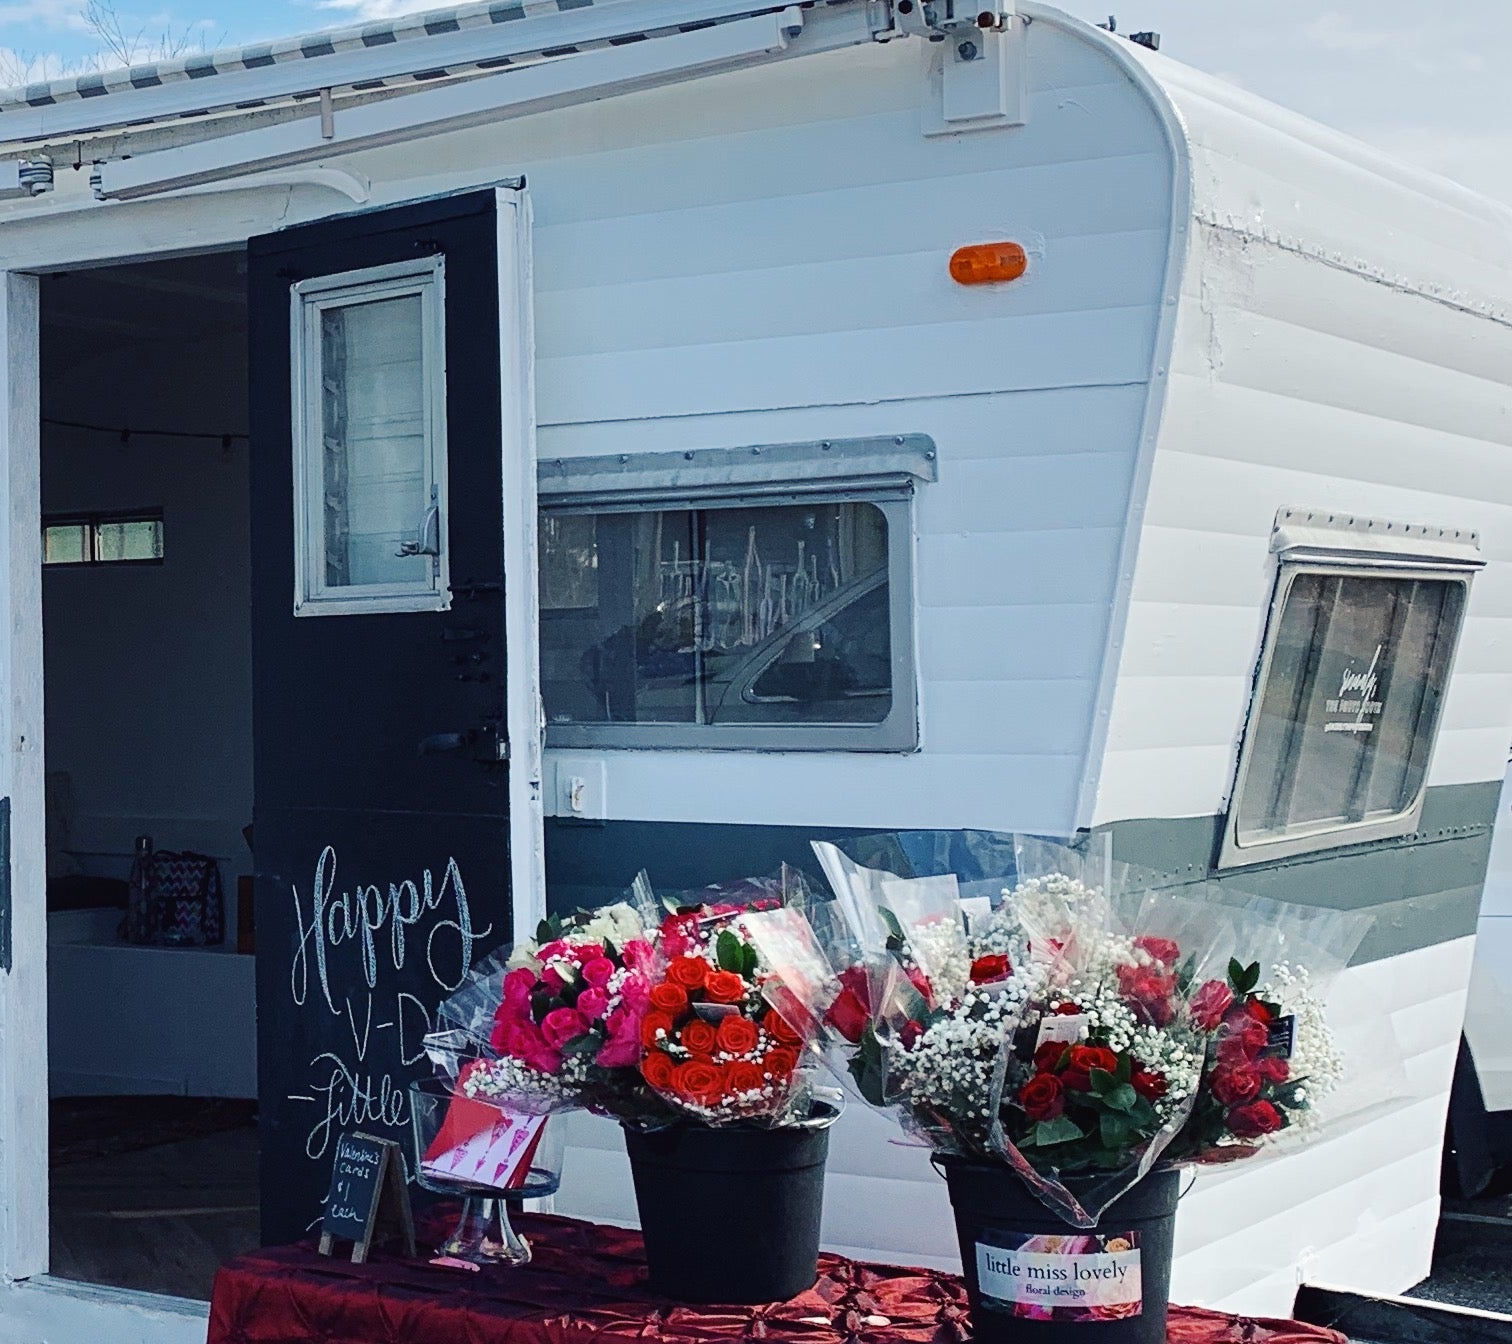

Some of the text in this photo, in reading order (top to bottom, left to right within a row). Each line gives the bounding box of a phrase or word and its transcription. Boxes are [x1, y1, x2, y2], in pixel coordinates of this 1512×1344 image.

[291, 845, 493, 1015] Happy
[346, 992, 432, 1066] V-D
[986, 1253, 1128, 1284] little miss lovely
[1025, 1283, 1086, 1299] floral design
